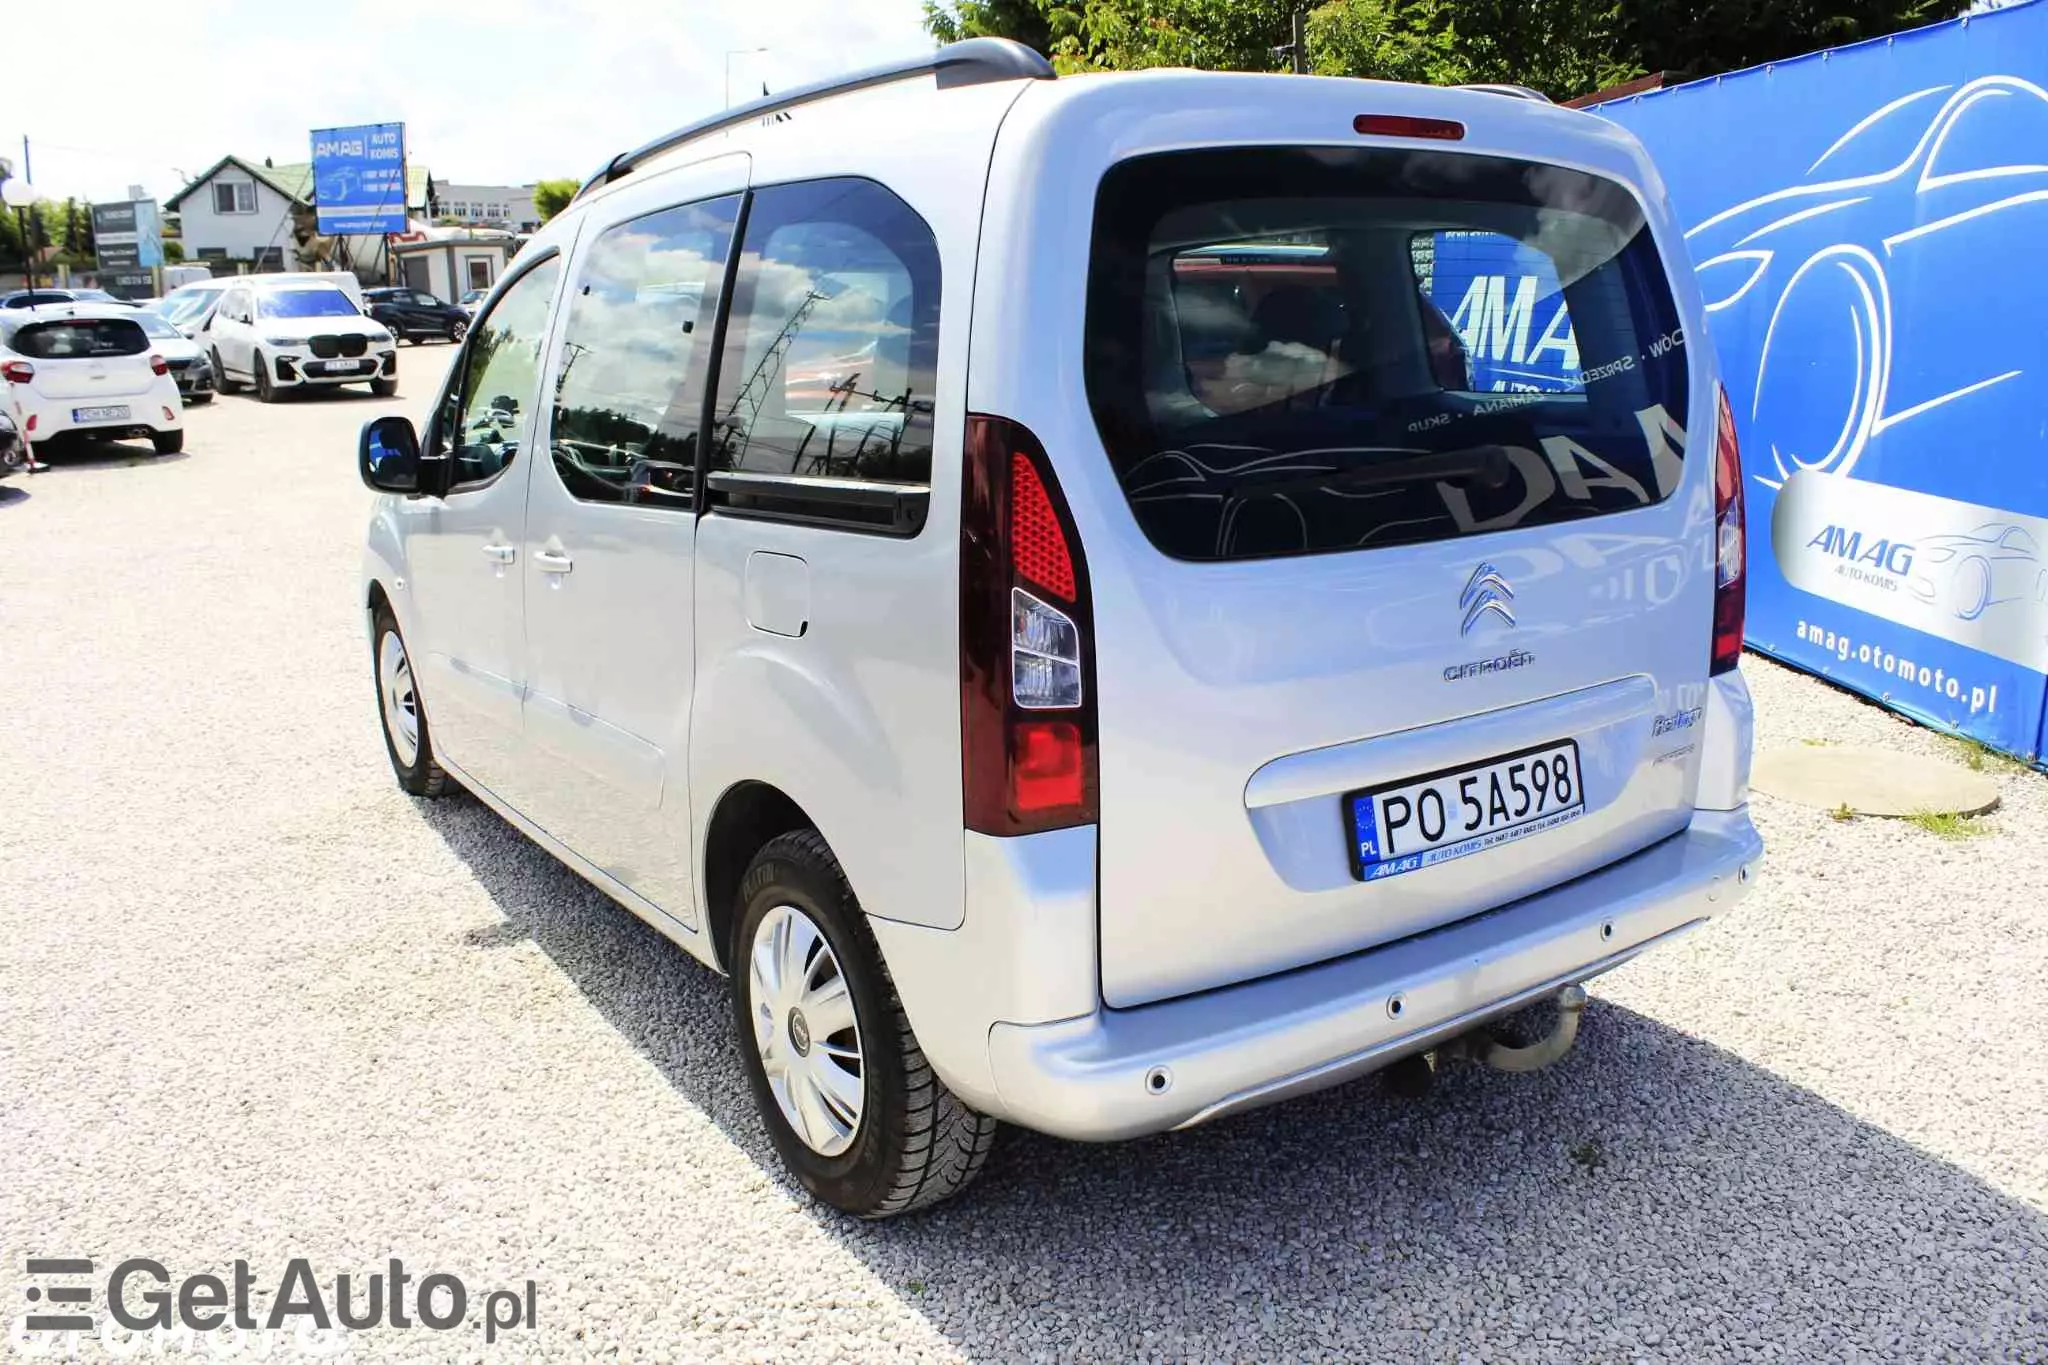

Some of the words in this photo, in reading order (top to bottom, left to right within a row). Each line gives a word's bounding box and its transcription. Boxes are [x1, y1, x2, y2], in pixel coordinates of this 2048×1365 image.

[316, 140, 363, 157] AMAG
[372, 132, 396, 145] AUTO
[1806, 525, 1916, 576] AMAG
[1834, 564, 1862, 582] AUTO
[1862, 572, 1898, 592] KOMIS
[1796, 619, 1998, 713] amag.otomoto.pl
[1382, 787, 1446, 854] PO
[1459, 754, 1572, 831] 5A598
[1360, 841, 1377, 857] PL
[1370, 856, 1420, 878] AMAG
